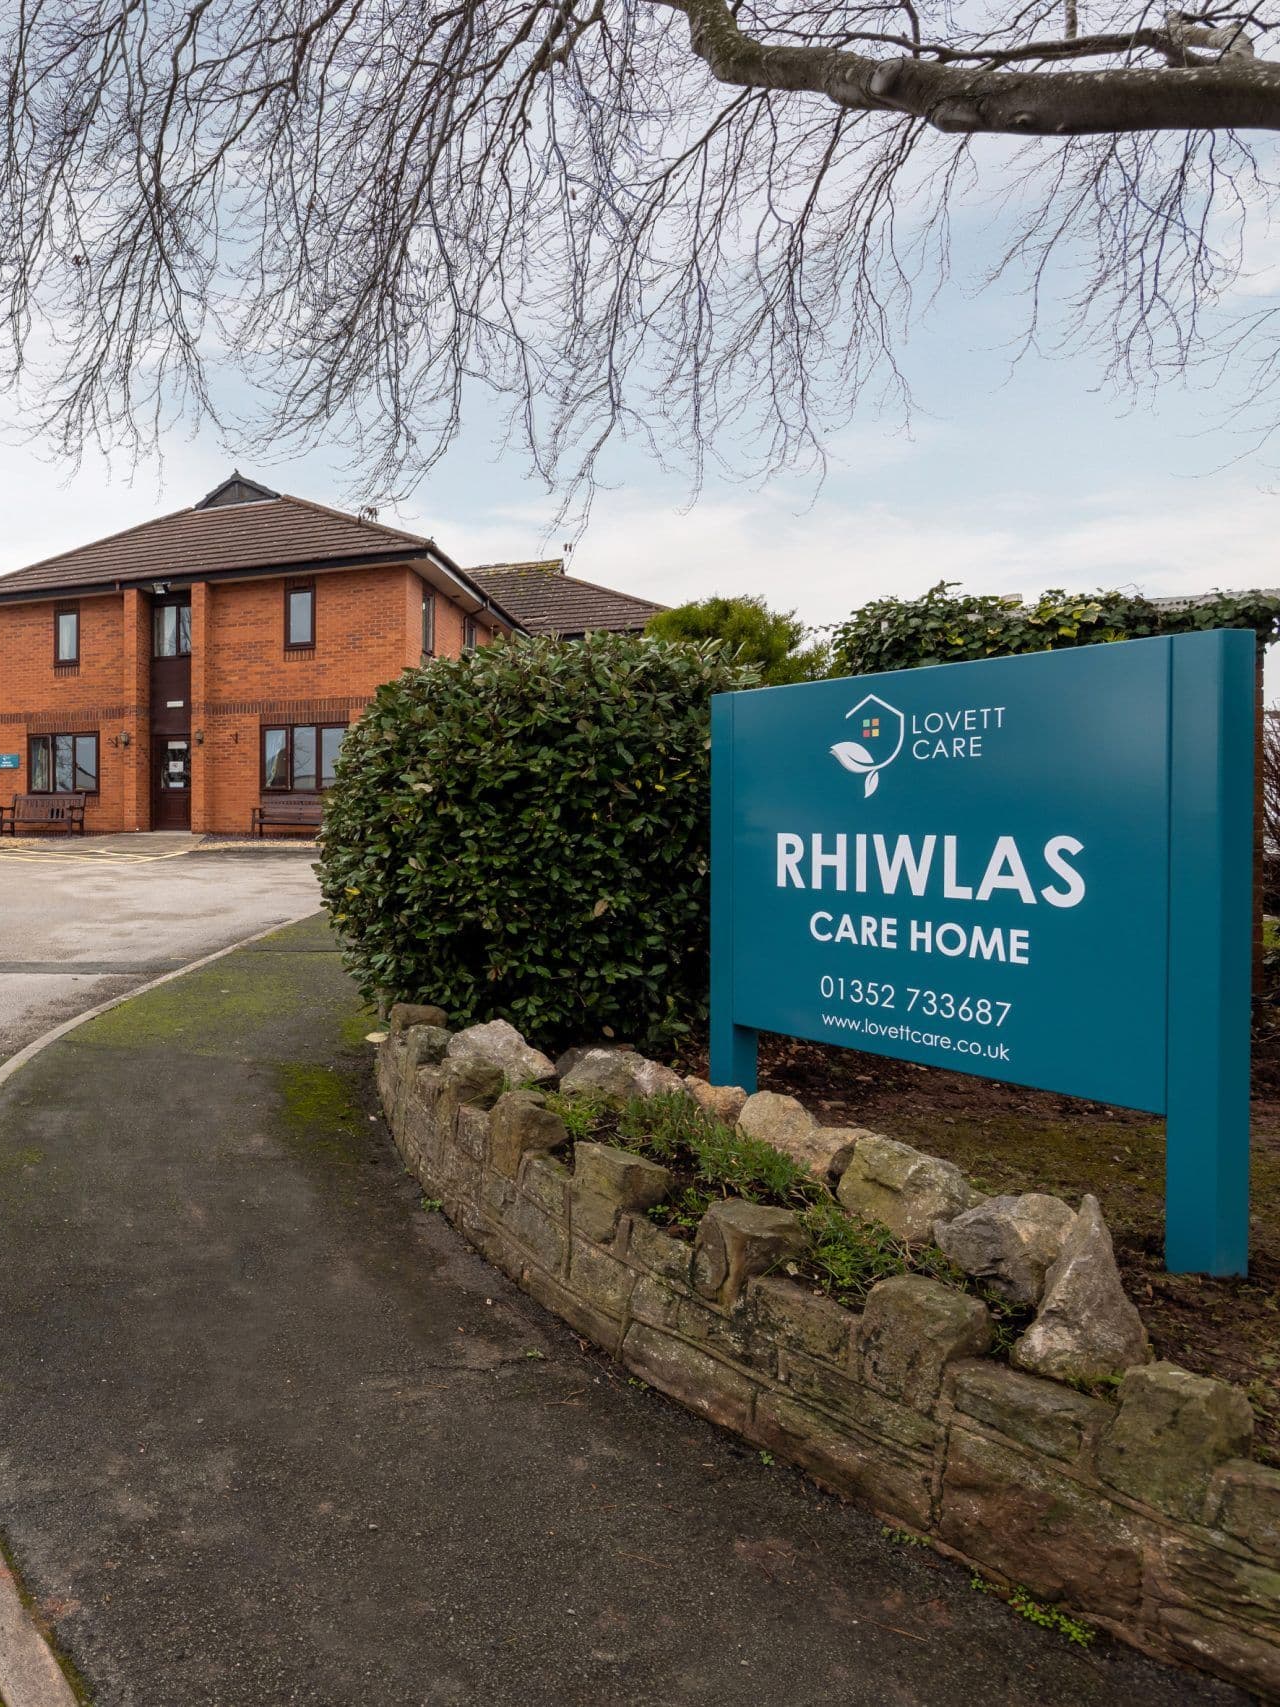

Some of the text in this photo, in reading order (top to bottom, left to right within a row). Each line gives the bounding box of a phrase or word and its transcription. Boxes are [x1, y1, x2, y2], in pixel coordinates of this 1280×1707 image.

[912, 707, 1006, 734] LOVETT
[912, 736, 982, 760] CARE
[776, 832, 1086, 908] RHIWLAS
[809, 911, 1030, 965] CARE HOME
[820, 975, 1012, 1028] 01352 733687
[821, 1012, 1011, 1062] www.lovettcare.co.uk
